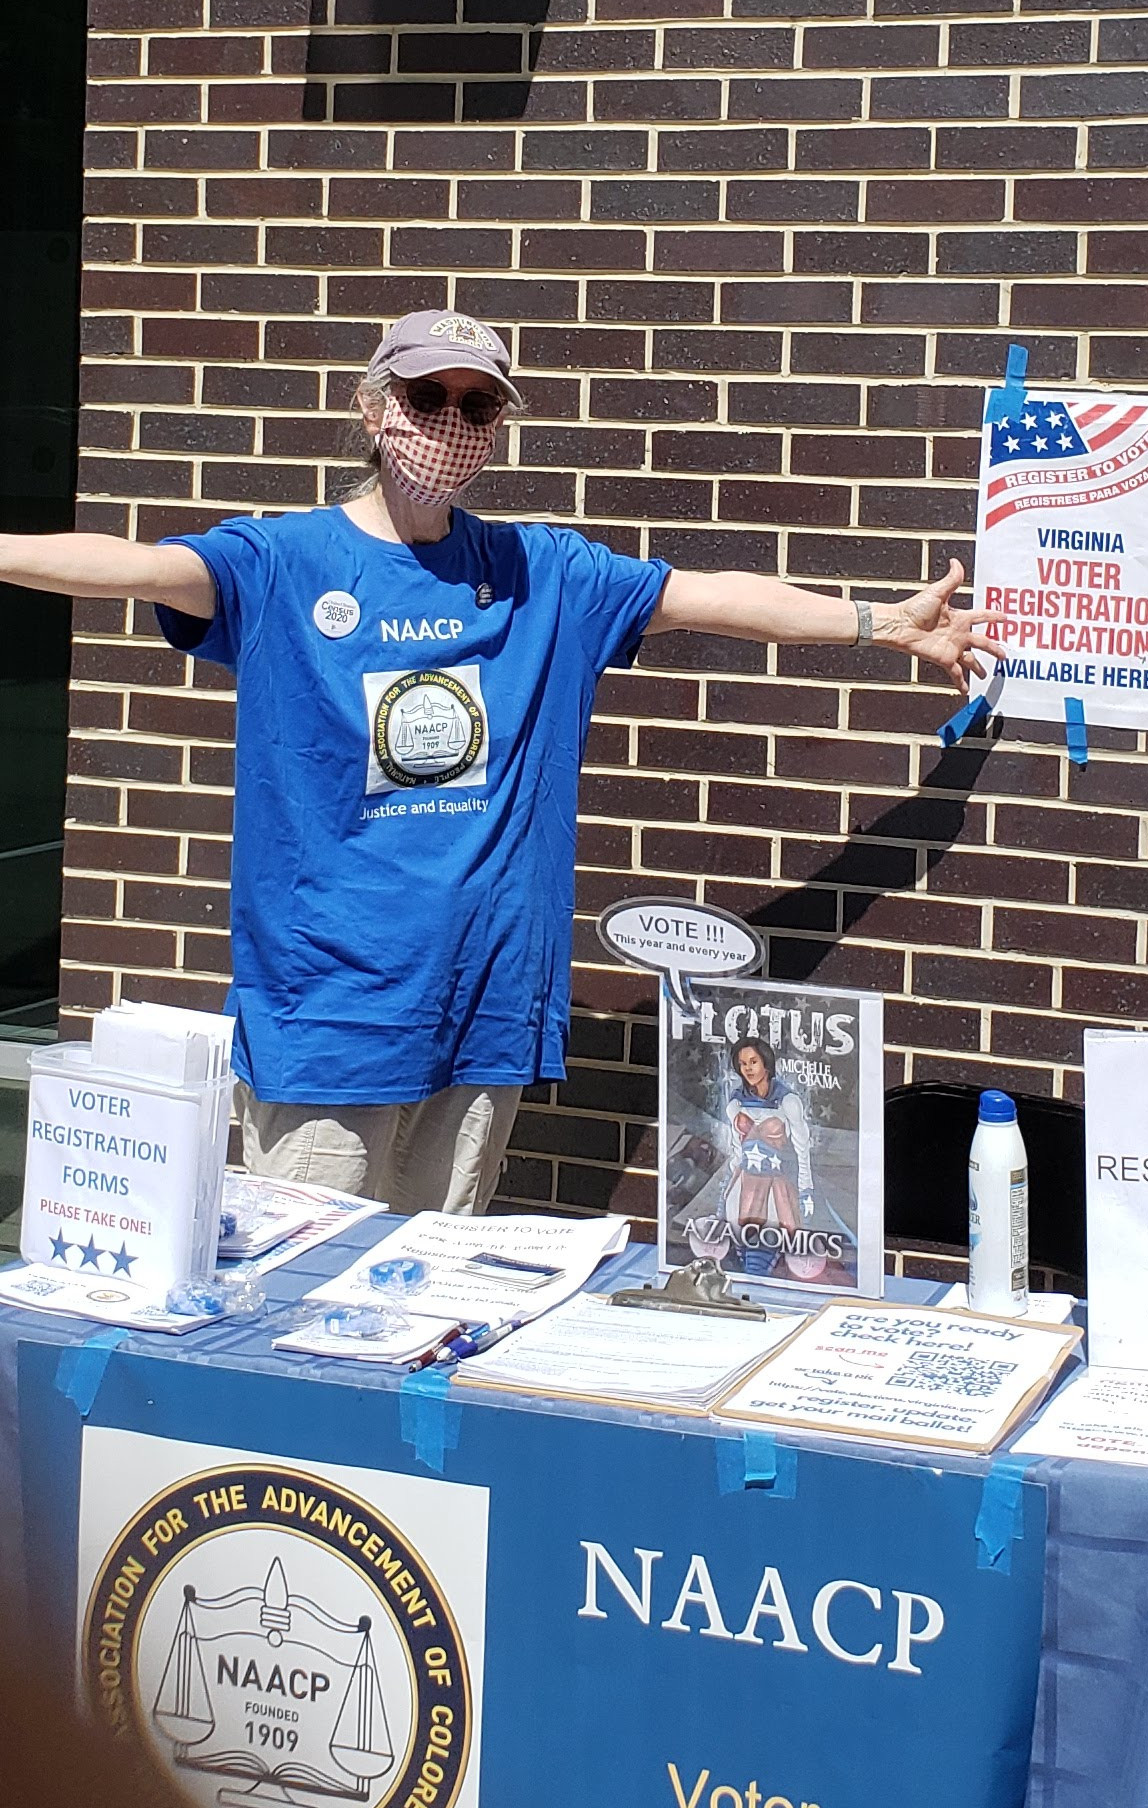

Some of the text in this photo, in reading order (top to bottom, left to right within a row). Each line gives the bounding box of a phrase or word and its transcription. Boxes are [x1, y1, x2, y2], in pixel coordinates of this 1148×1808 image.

[1005, 468, 1089, 489] REGISTER
[1092, 461, 1115, 476] TO
[1014, 493, 1087, 511] REGISTRESE
[1089, 486, 1119, 501] PARA
[1037, 527, 1125, 554] VIRGINIA
[1037, 557, 1121, 591] VOTER
[325, 610, 348, 623] 2020
[381, 618, 463, 642] NAACP
[993, 658, 1096, 685] AVAILABLE
[377, 673, 481, 762] ASSOCIATION FOR THE ADVANCEMENT OF COLORED
[414, 723, 448, 735] NAACP
[422, 741, 440, 750] 1909
[360, 798, 489, 820] Justice and Equality
[639, 914, 698, 940] VOTE
[613, 933, 746, 962] This year and every year
[671, 1001, 855, 1055] FLOTUS
[781, 1058, 831, 1076] MICHELLE
[69, 1088, 130, 1118] VOTER
[32, 1120, 167, 1164] REGISTRATION
[63, 1165, 130, 1196] FORMS
[40, 1198, 152, 1236] PLEASE TAKE ONE!
[740, 1224, 843, 1259] COMICS
[830, 1329, 974, 1351] check here!
[838, 1321, 941, 1338] to vote?
[846, 1314, 1024, 1341] are you ready
[749, 1399, 789, 1410] get
[789, 1402, 844, 1415] your
[847, 1409, 898, 1423] mail
[797, 1395, 887, 1411] register.
[142, 1507, 189, 1555] FOR
[193, 1485, 248, 1519] THE
[261, 1485, 437, 1631] ADVANCEMENT
[424, 1646, 452, 1687] OF
[577, 1540, 945, 1674] NAACP
[216, 1653, 331, 1702] NAACP
[244, 1702, 299, 1723] FOUNDED
[244, 1721, 299, 1752] 1909
